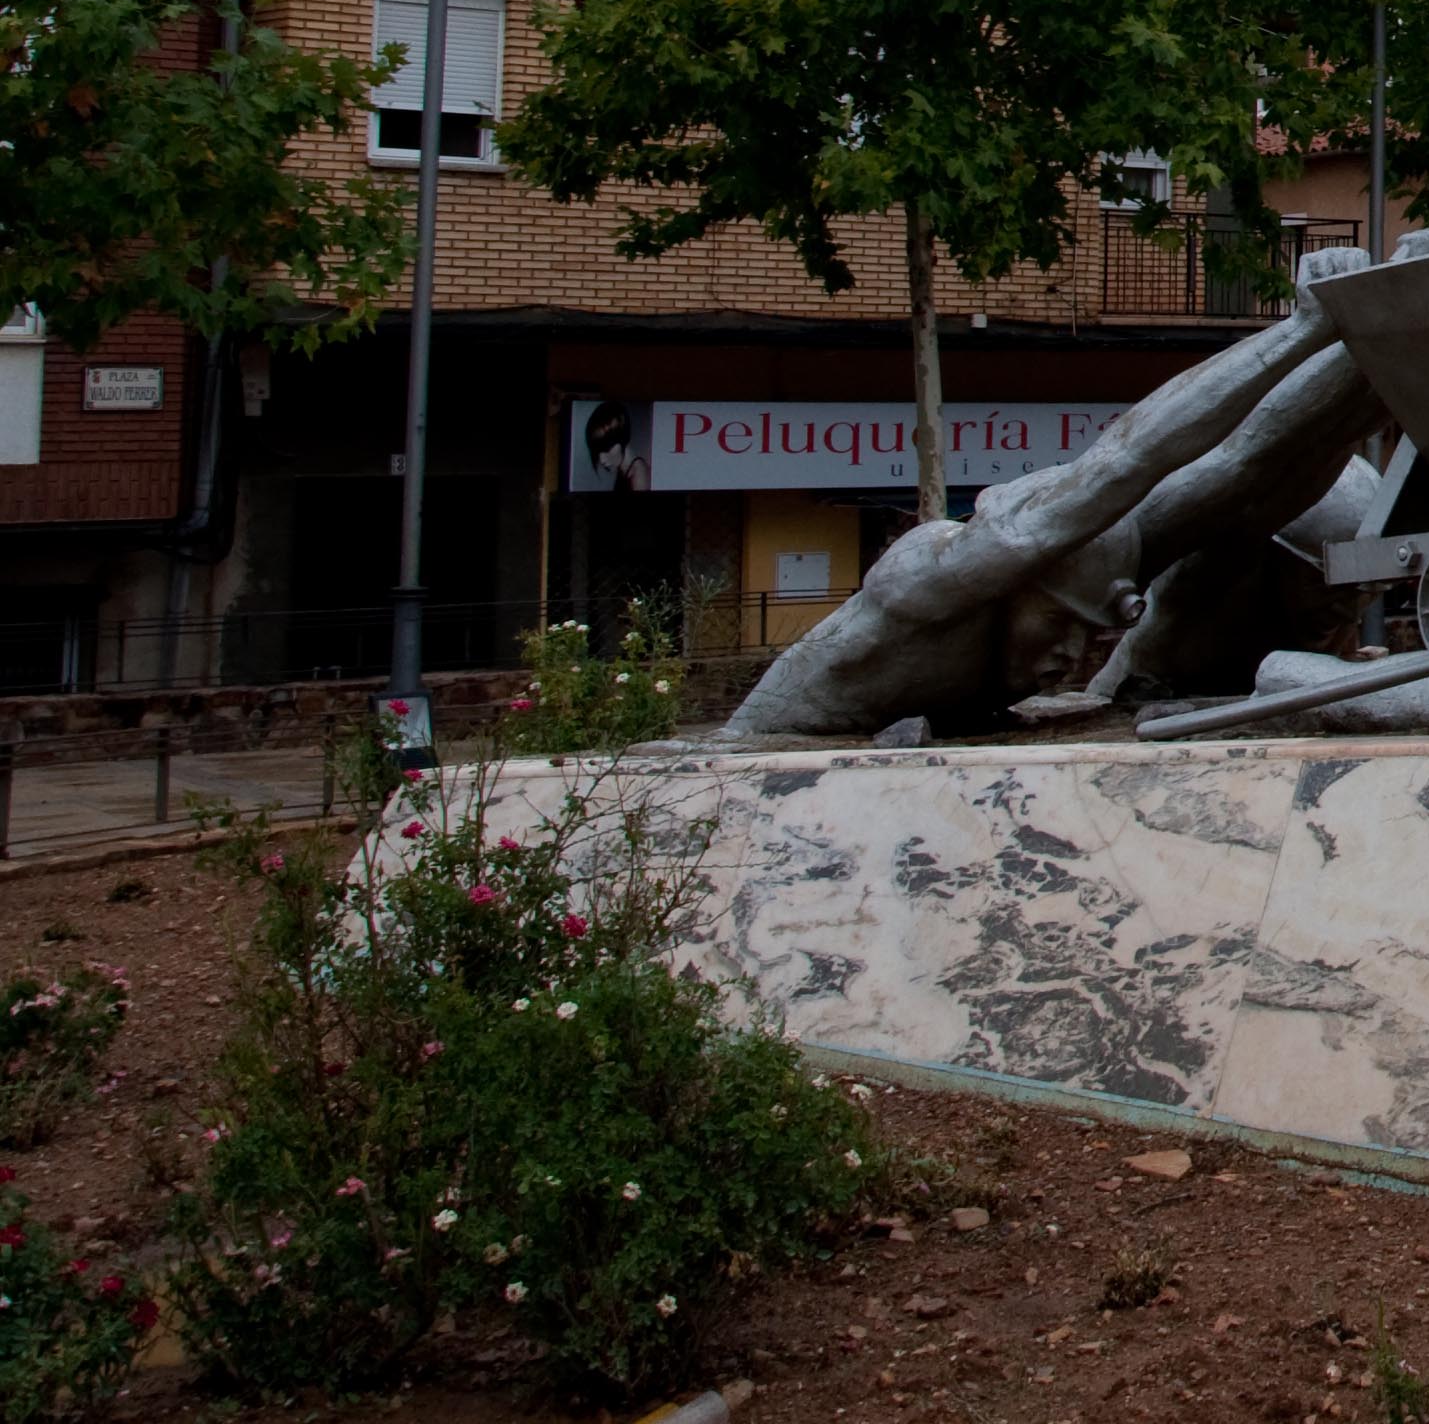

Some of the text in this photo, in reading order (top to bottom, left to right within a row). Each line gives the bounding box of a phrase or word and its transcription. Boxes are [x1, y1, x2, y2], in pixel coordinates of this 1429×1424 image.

[108, 371, 140, 382] PLAZA
[89, 386, 158, 401] WALDO FERRER
[669, 410, 1032, 466] Peluquría
